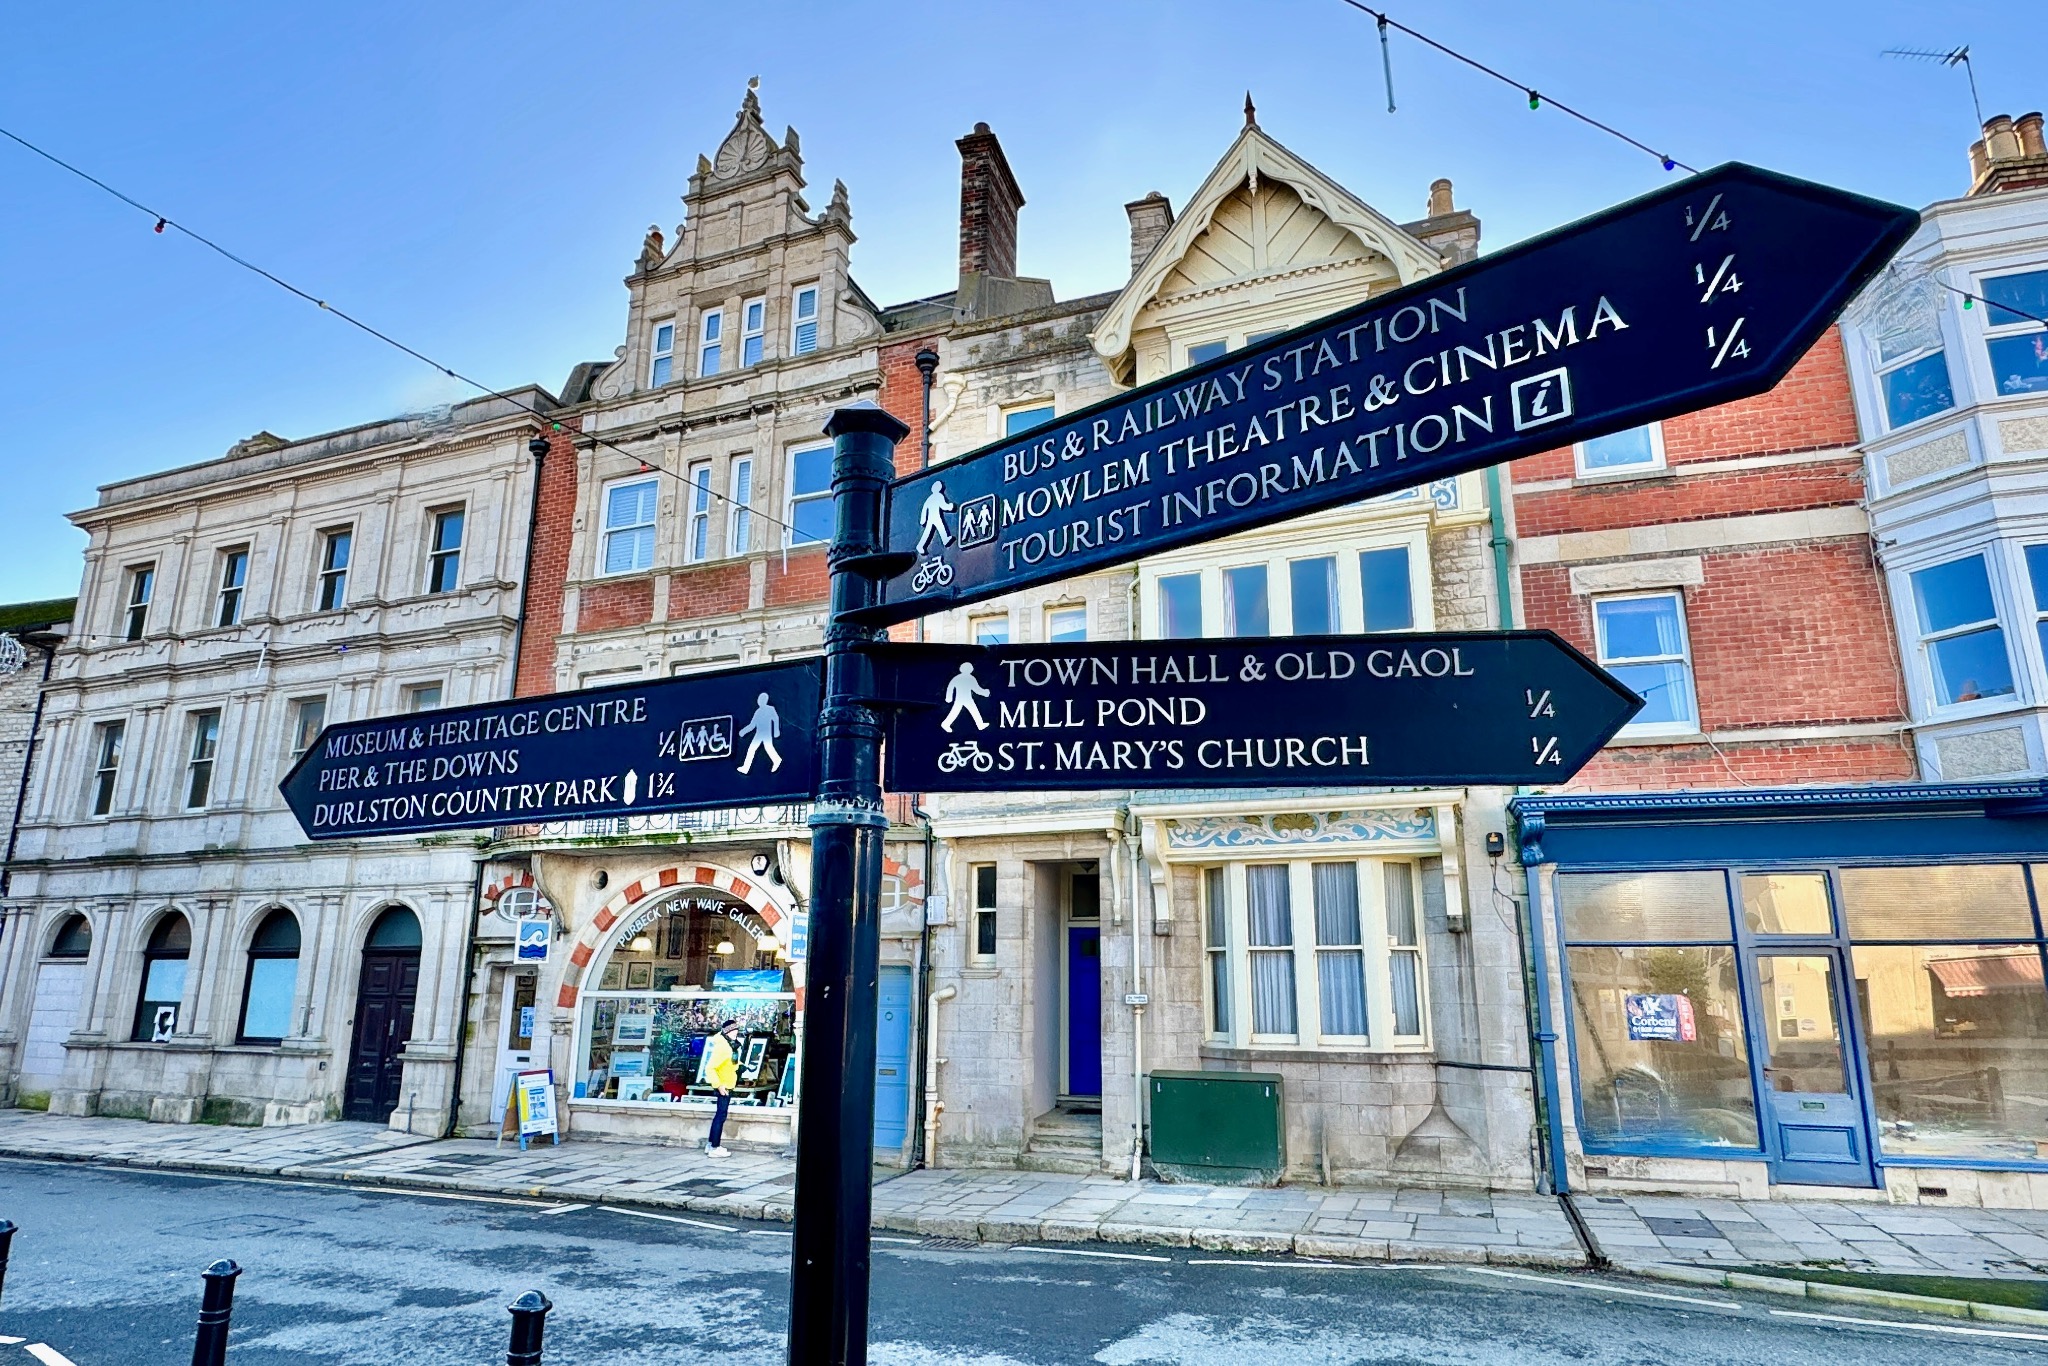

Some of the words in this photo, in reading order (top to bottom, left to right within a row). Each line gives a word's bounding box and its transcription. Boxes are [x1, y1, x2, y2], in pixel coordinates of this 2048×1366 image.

[1003, 438, 1056, 482] BUS
[1061, 431, 1085, 461] &
[1093, 365, 1253, 451] RAILWAY
[1264, 287, 1467, 391] STATION
[1001, 451, 1151, 527] MOWLEM
[1158, 385, 1356, 475] THEATRE
[1364, 375, 1400, 412] &
[1404, 296, 1630, 395] CINEMA
[1002, 500, 1151, 570] TOURIST
[1161, 396, 1494, 527] INFORMATION
[1000, 657, 1119, 687] TOWN
[1132, 655, 1230, 684] HALL
[1239, 655, 1267, 682] &
[1276, 652, 1356, 680] OLD
[1367, 648, 1475, 677] GAOL
[325, 728, 408, 758] MUSEUM
[409, 727, 424, 749] &
[429, 711, 540, 746] HERITAGE
[545, 698, 648, 732] CENTRE
[1000, 700, 1085, 728] MILL
[1097, 697, 1206, 727] POND
[319, 766, 361, 791] PIER
[364, 766, 379, 787] &
[384, 758, 428, 785] THE
[432, 749, 519, 780] DOWNS
[998, 742, 1046, 771] ST.
[1055, 740, 1184, 770] MARY'S
[1198, 736, 1370, 768] CHURCH
[313, 794, 429, 827] DURLSTON
[432, 783, 551, 817] COUNTRY
[554, 776, 618, 806] PARK
[617, 907, 662, 947] PURBECK
[666, 898, 690, 914] NEW
[696, 898, 726, 914] WAVE
[729, 908, 767, 941] GALLER
[1632, 1015, 1677, 1027] Corbens
